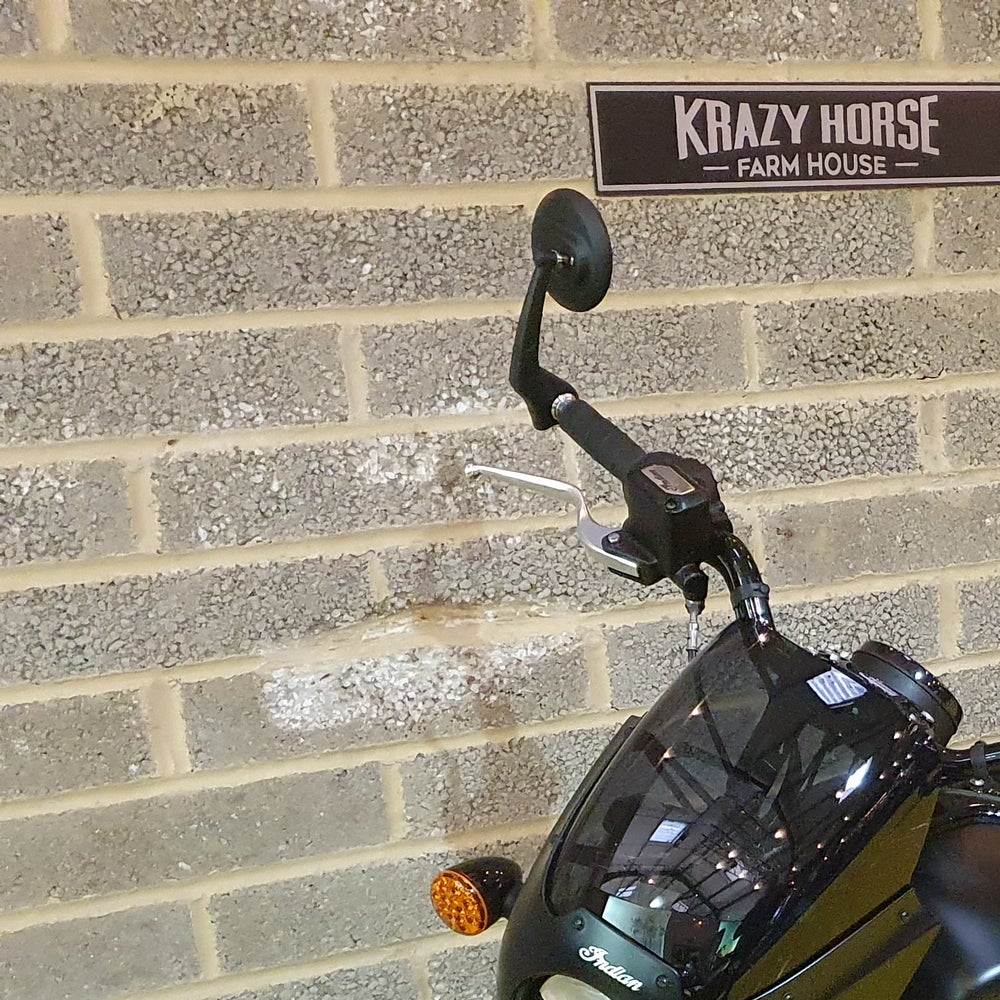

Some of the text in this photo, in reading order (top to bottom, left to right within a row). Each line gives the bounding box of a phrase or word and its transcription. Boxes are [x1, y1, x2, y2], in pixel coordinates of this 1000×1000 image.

[674, 95, 940, 160] KRAZY HORSE
[737, 152, 887, 177] FARM HOUSE
[578, 945, 643, 991] Indian
